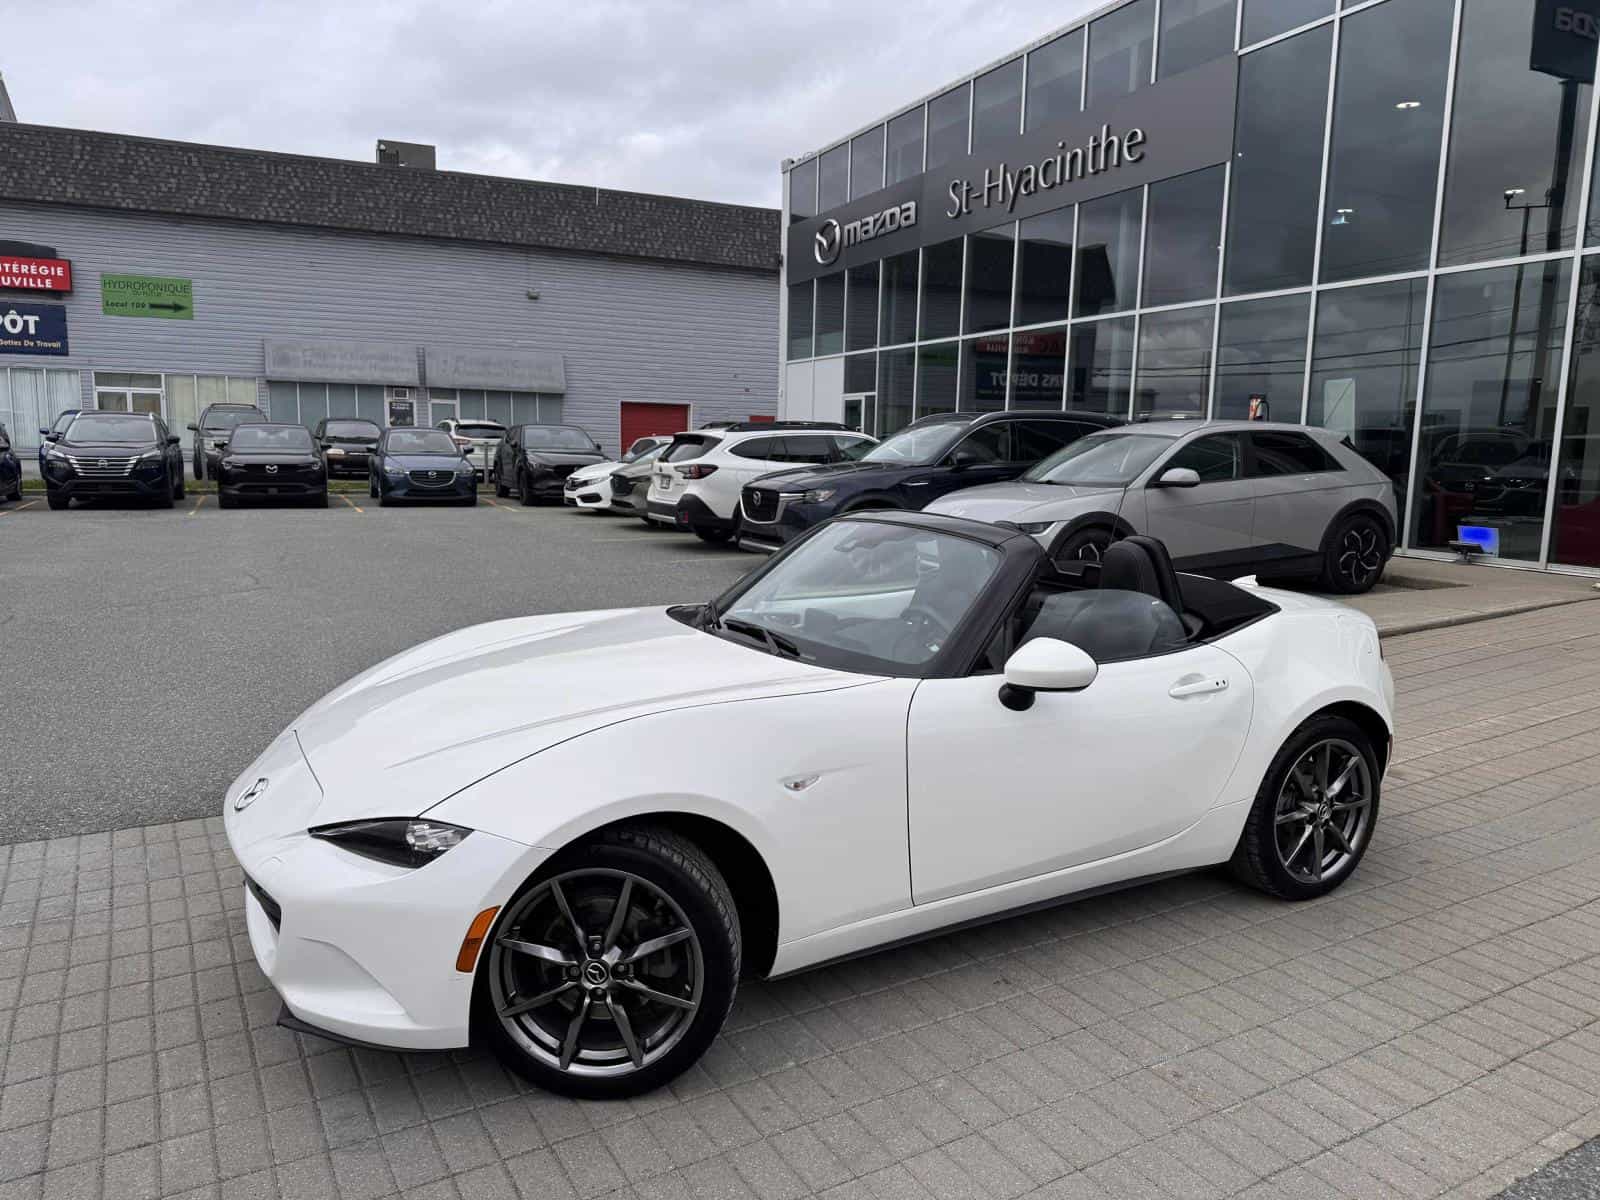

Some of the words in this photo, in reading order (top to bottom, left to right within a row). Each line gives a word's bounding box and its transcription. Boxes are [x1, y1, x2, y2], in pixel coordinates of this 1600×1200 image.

[946, 123, 1147, 219] St-Hyacinthe
[843, 201, 917, 249] mazda
[0, 261, 64, 277] TÉRÉGIE
[103, 279, 191, 295] HYDROPONIQUE
[0, 310, 40, 335] ÔT
